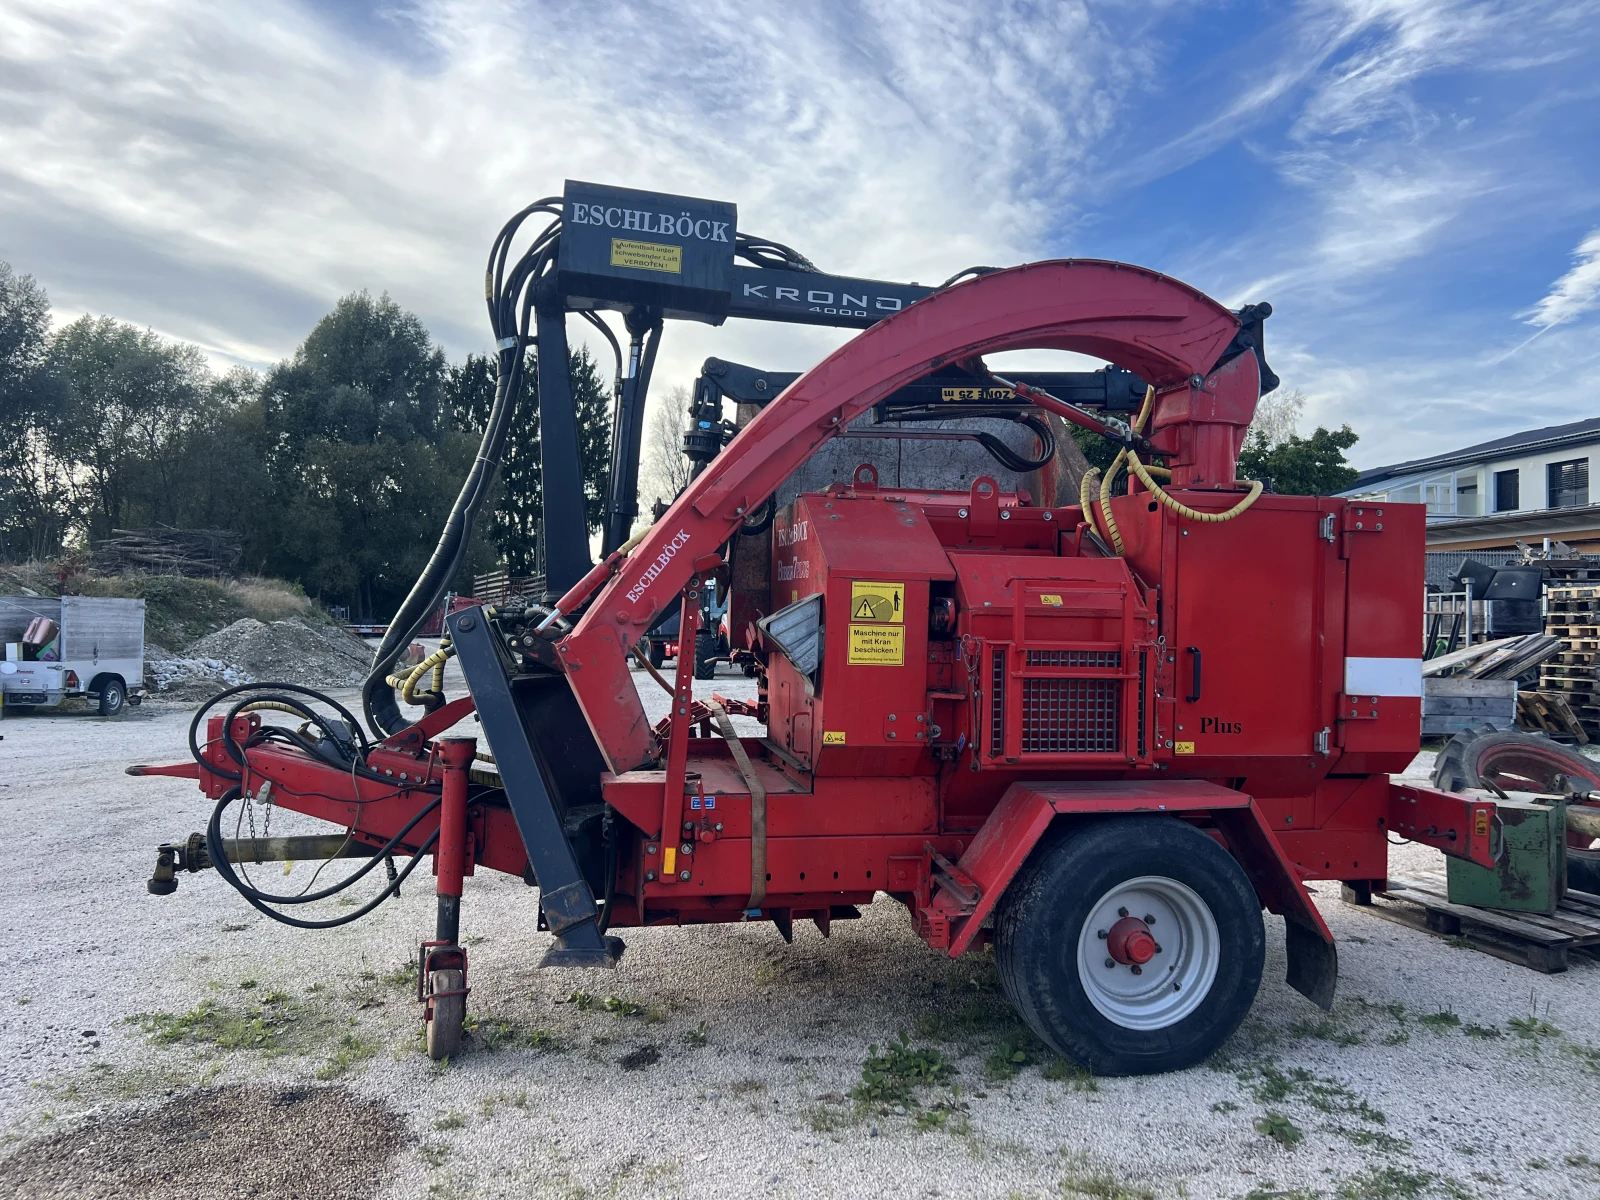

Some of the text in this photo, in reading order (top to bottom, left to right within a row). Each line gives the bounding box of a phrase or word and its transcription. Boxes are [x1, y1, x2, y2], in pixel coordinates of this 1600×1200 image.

[571, 202, 730, 243] ESCHLBÖCK
[619, 241, 655, 252] Aufenthalt
[614, 250, 662, 260] schwebender
[624, 258, 664, 269] VERBOTEN
[809, 306, 867, 317] 4000
[958, 390, 973, 399] 25
[625, 528, 691, 604] ESCHLBÖCK
[853, 629, 886, 637] Maschine
[854, 646, 894, 654] beschicken
[1200, 716, 1242, 734] Plus
